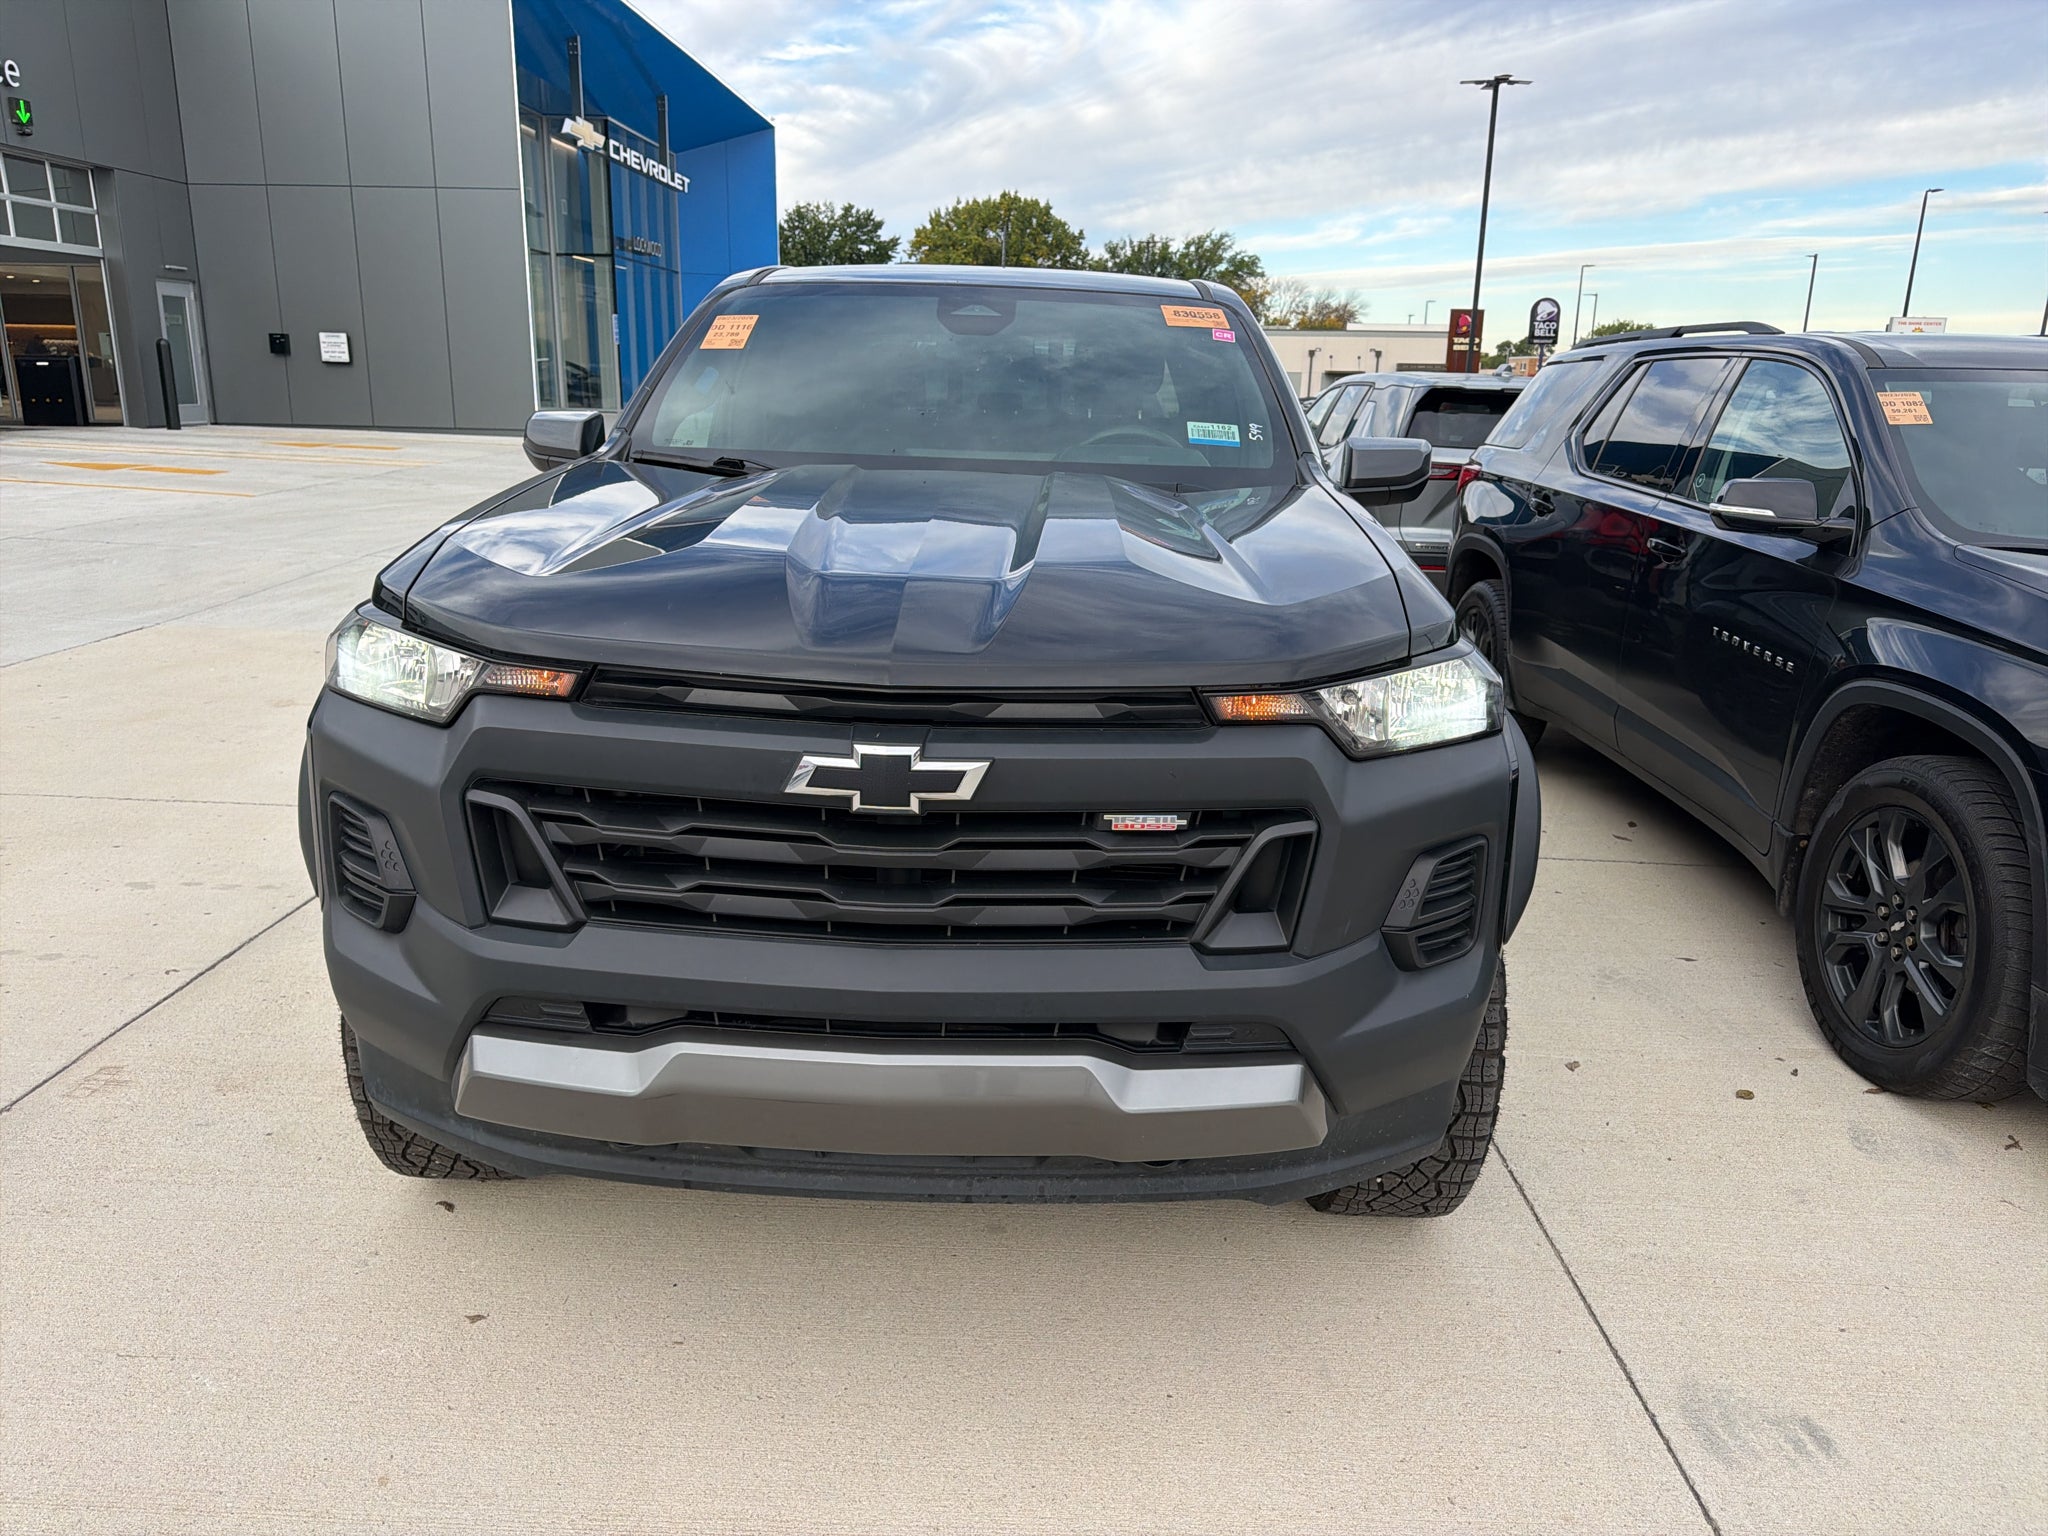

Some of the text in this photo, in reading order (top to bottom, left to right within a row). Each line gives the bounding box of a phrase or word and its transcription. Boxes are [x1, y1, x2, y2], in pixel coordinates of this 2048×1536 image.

[608, 139, 691, 193] CHEVROLET
[1533, 321, 1557, 330] TACO
[1215, 331, 1232, 339] CR
[1533, 329, 1556, 337] BELL
[1712, 625, 1795, 675] TRAVERSE
[1103, 814, 1188, 825] TRAIL
[1112, 823, 1177, 831] BOSS
